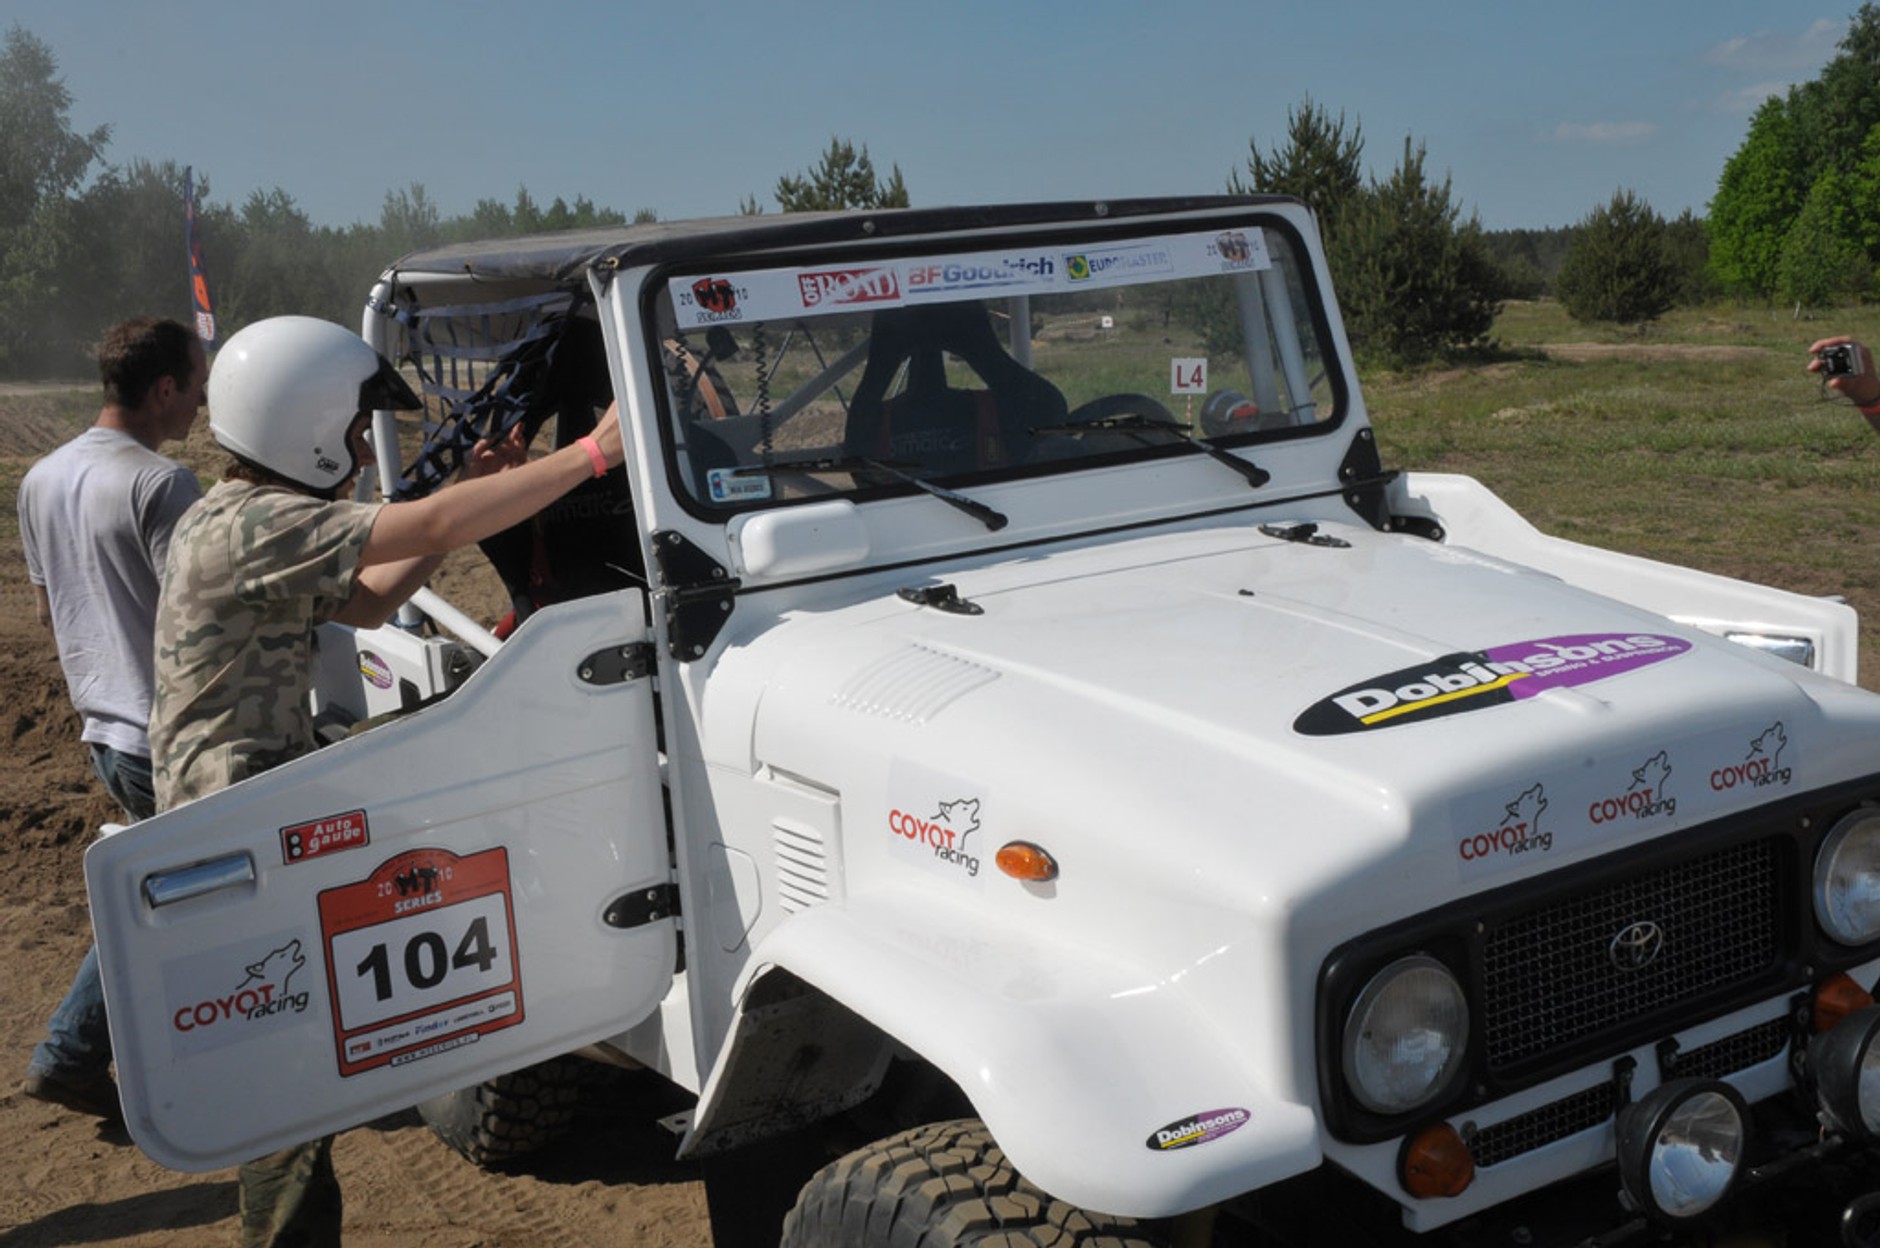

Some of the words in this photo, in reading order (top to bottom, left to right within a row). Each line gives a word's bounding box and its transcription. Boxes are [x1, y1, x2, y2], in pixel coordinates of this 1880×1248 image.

[1176, 364, 1204, 388] L4
[1333, 633, 1668, 719] Dobinsons
[1709, 757, 1771, 792] COYOT
[1753, 766, 1792, 788] racing
[1589, 788, 1654, 825] COYOT
[1636, 797, 1677, 820] racing
[307, 827, 362, 855] gauge
[314, 818, 352, 836] Auto
[888, 808, 956, 849] COYOT
[1459, 823, 1528, 861] COYOT
[1508, 831, 1553, 857] racing
[934, 844, 980, 877] racing
[377, 881, 393, 897] 20
[439, 866, 453, 882] 10
[394, 890, 443, 914] SERIES
[356, 916, 498, 1002] 104
[173, 983, 276, 1033] COYOT
[246, 991, 310, 1022] racing
[1157, 1109, 1245, 1144] Dobinsons
